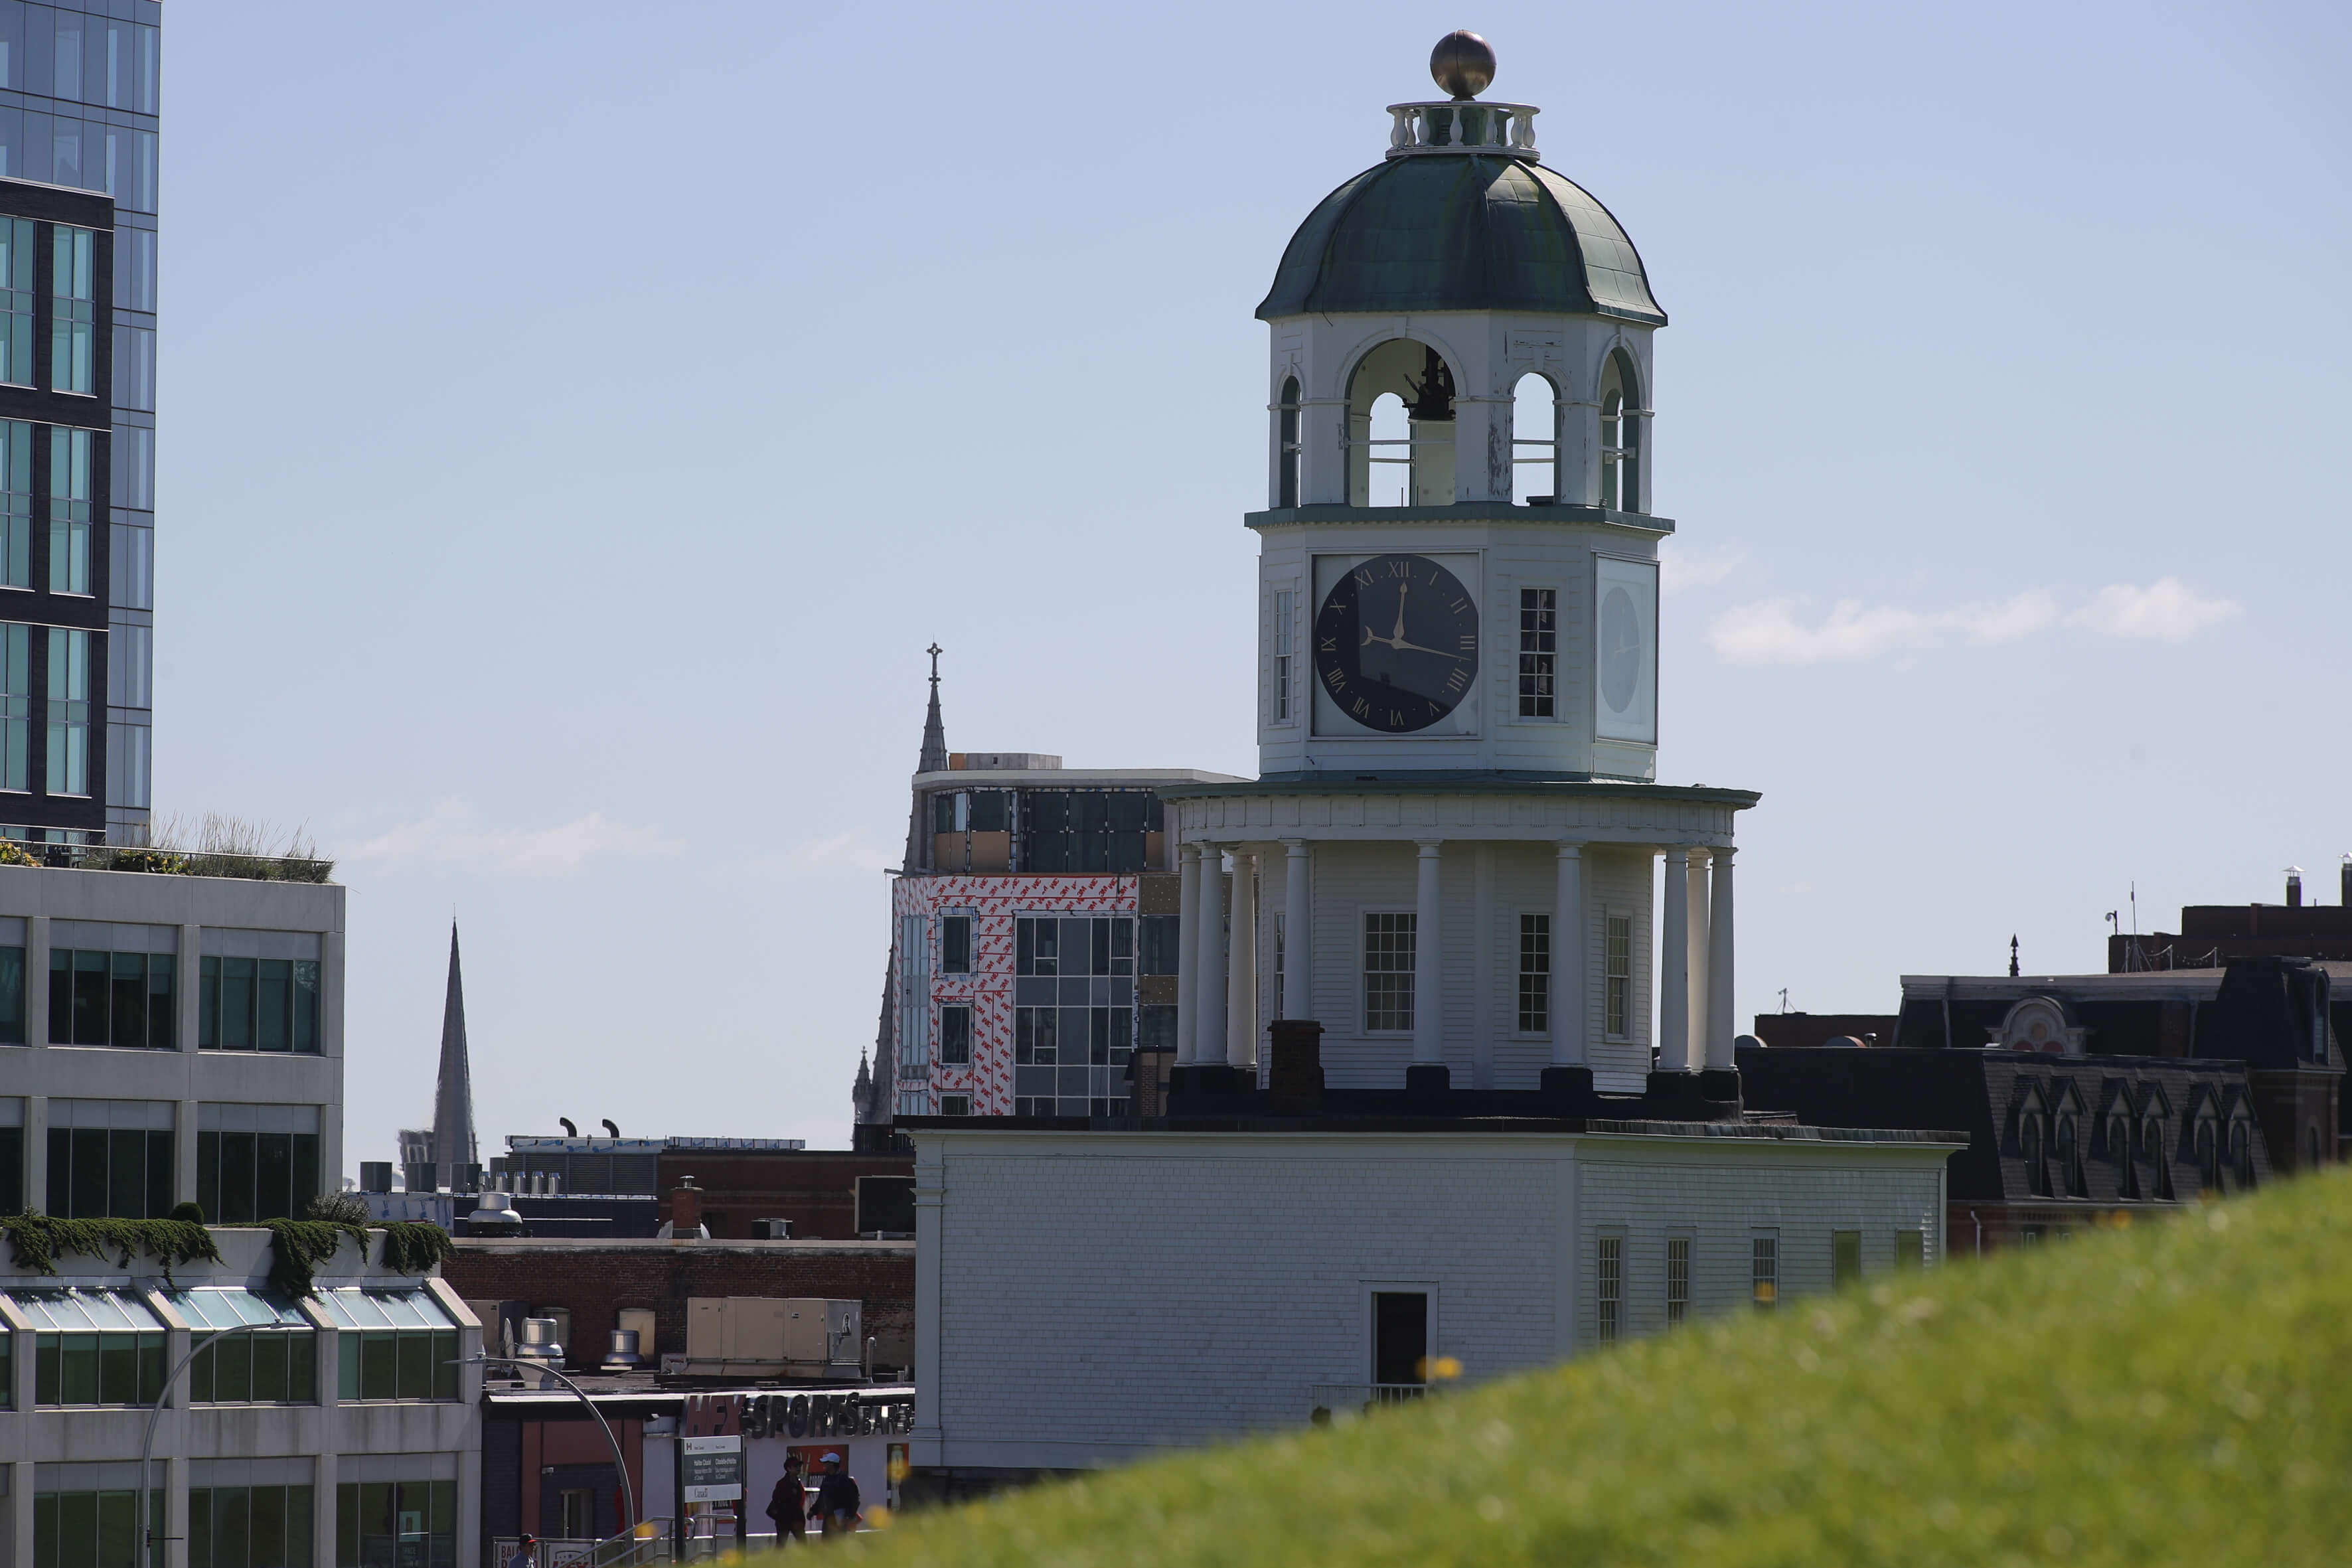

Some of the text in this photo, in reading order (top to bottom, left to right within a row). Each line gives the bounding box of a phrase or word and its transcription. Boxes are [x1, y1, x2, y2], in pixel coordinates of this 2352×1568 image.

[1387, 561, 1409, 578] XII
[1429, 570, 1438, 586] I
[1354, 569, 1374, 589] XI
[1329, 598, 1346, 615] X
[1450, 597, 1468, 614] II
[1321, 637, 1337, 651] IX
[1460, 635, 1476, 650] III
[1327, 668, 1347, 694] VIII
[1447, 668, 1469, 692] IIII
[1353, 696, 1370, 718] VII
[1428, 700, 1440, 717] V
[1390, 709, 1404, 726] VI
[684, 1394, 745, 1437] HFX
[747, 1393, 860, 1439] SPORTS
[859, 1404, 897, 1436] BAR
